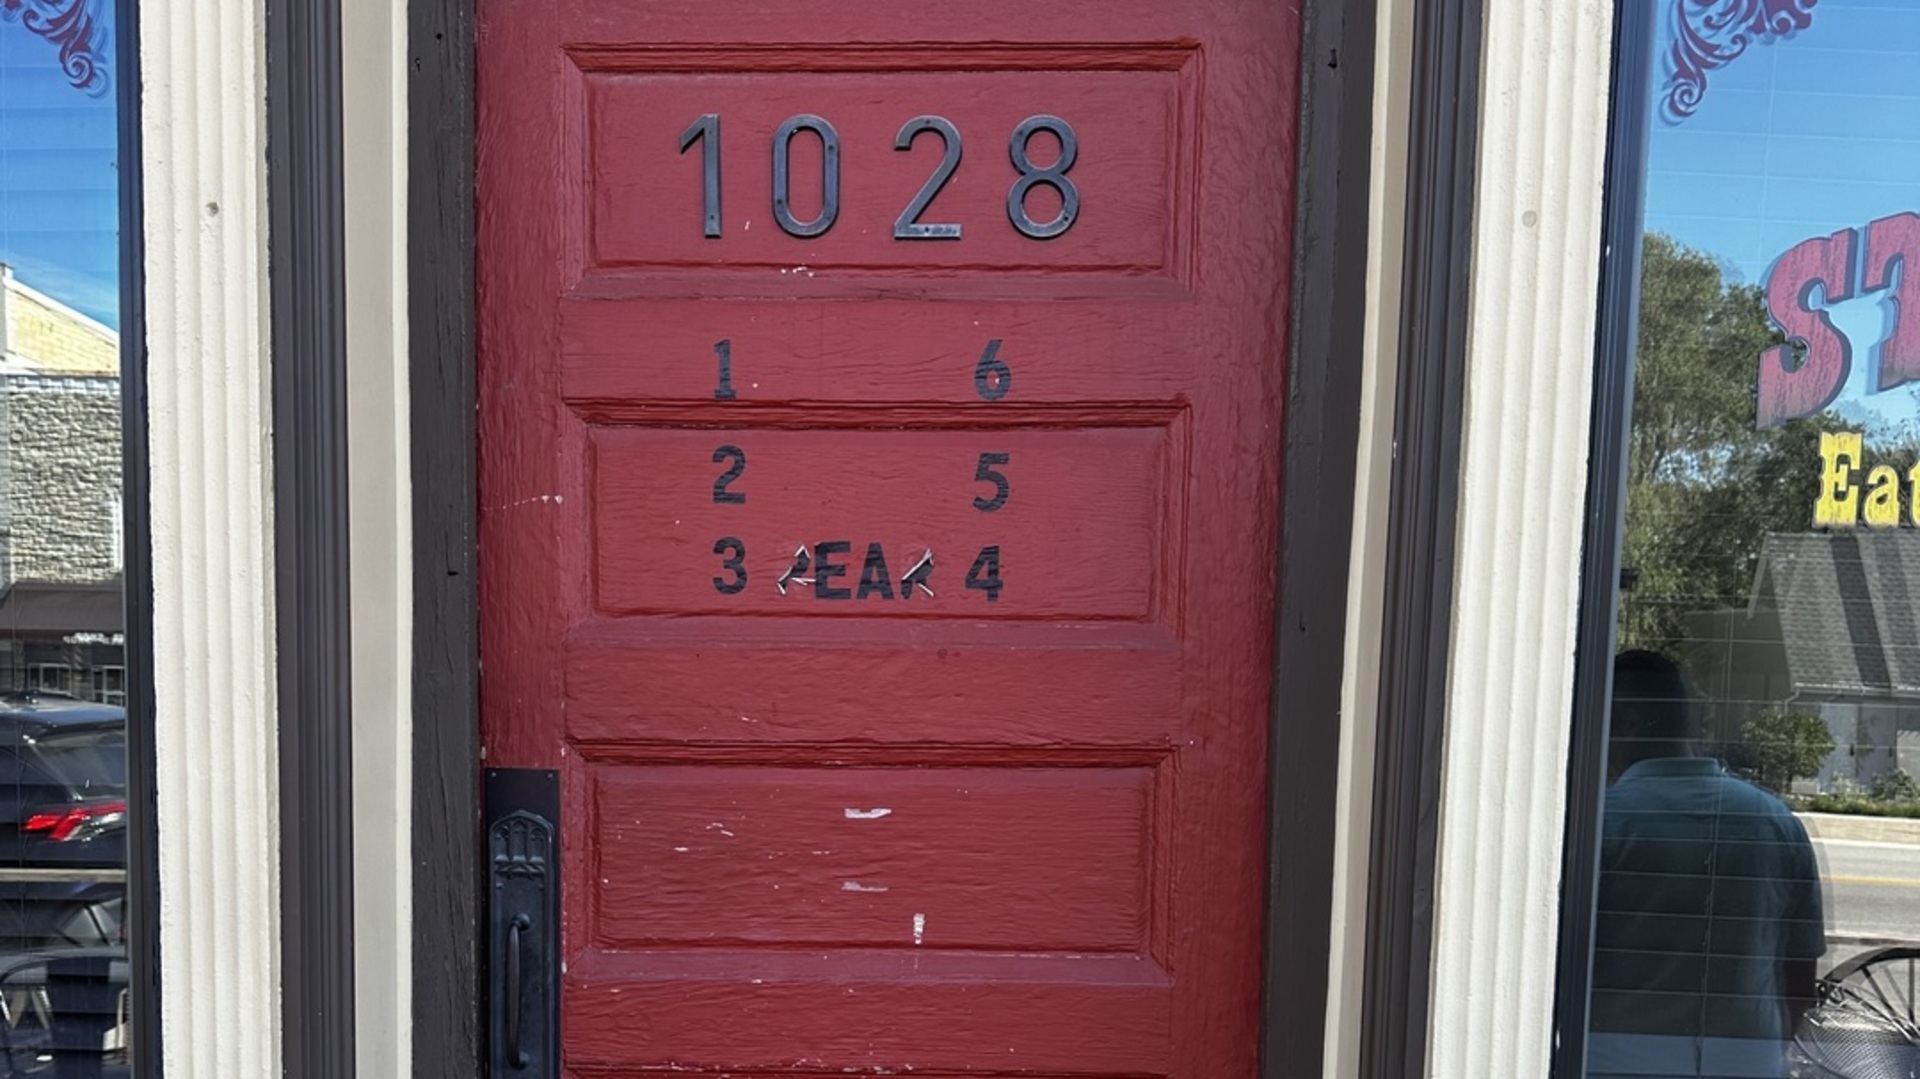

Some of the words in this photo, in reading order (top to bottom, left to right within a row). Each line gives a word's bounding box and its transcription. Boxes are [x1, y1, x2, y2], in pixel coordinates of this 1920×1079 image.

[678, 113, 1080, 240] 1028
[713, 338, 737, 400] 1
[973, 338, 1012, 401] 6
[711, 445, 746, 504] 2
[972, 452, 1010, 512] 5
[712, 536, 748, 595] 3
[964, 545, 1003, 602] 4
